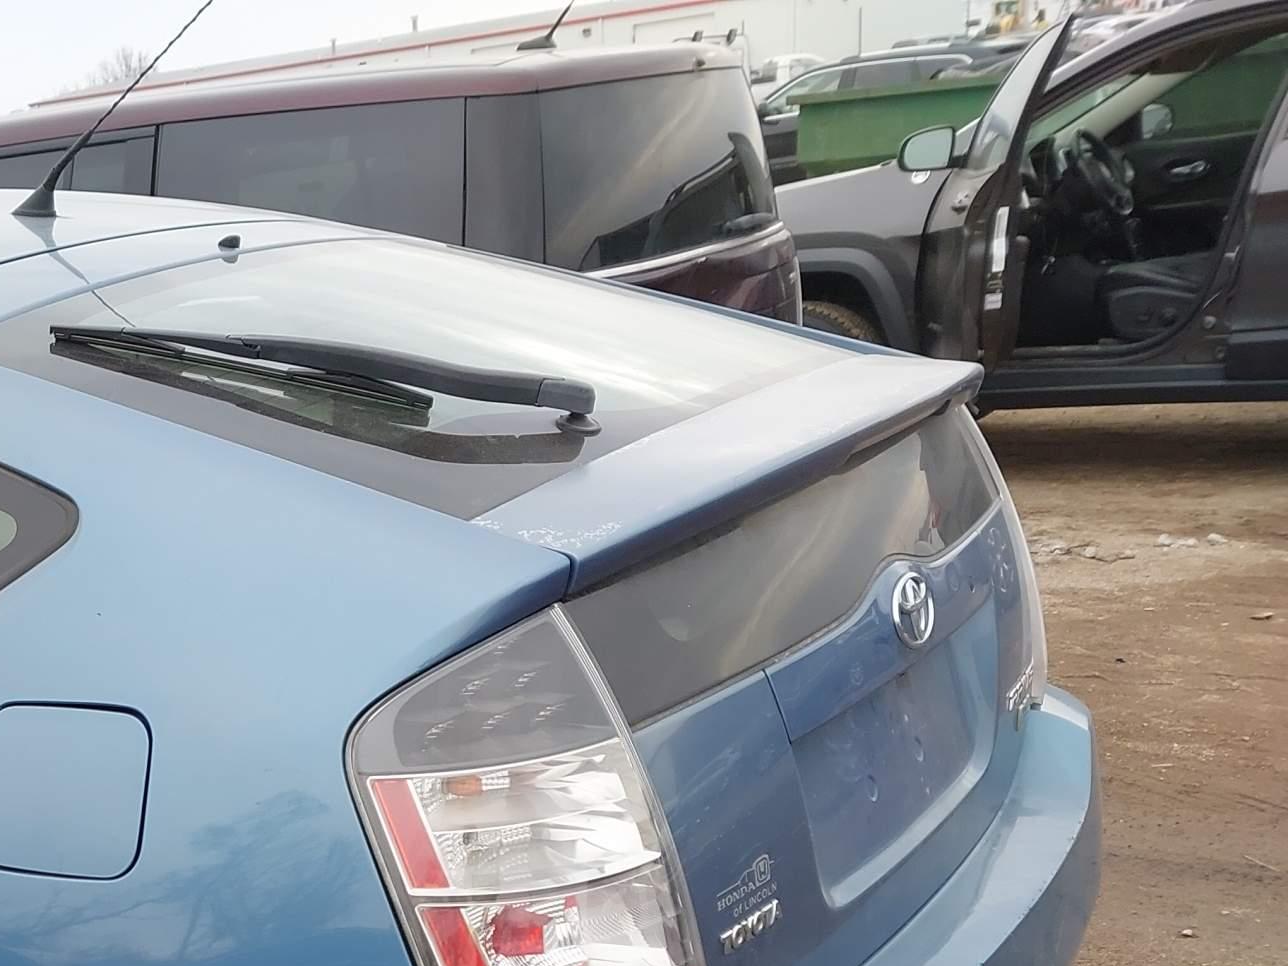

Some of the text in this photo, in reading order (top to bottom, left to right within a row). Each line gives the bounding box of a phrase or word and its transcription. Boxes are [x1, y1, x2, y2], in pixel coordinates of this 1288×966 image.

[717, 882, 756, 911] HONDA
[744, 881, 777, 910] LINCOLN
[720, 899, 783, 954] TOYOTA
